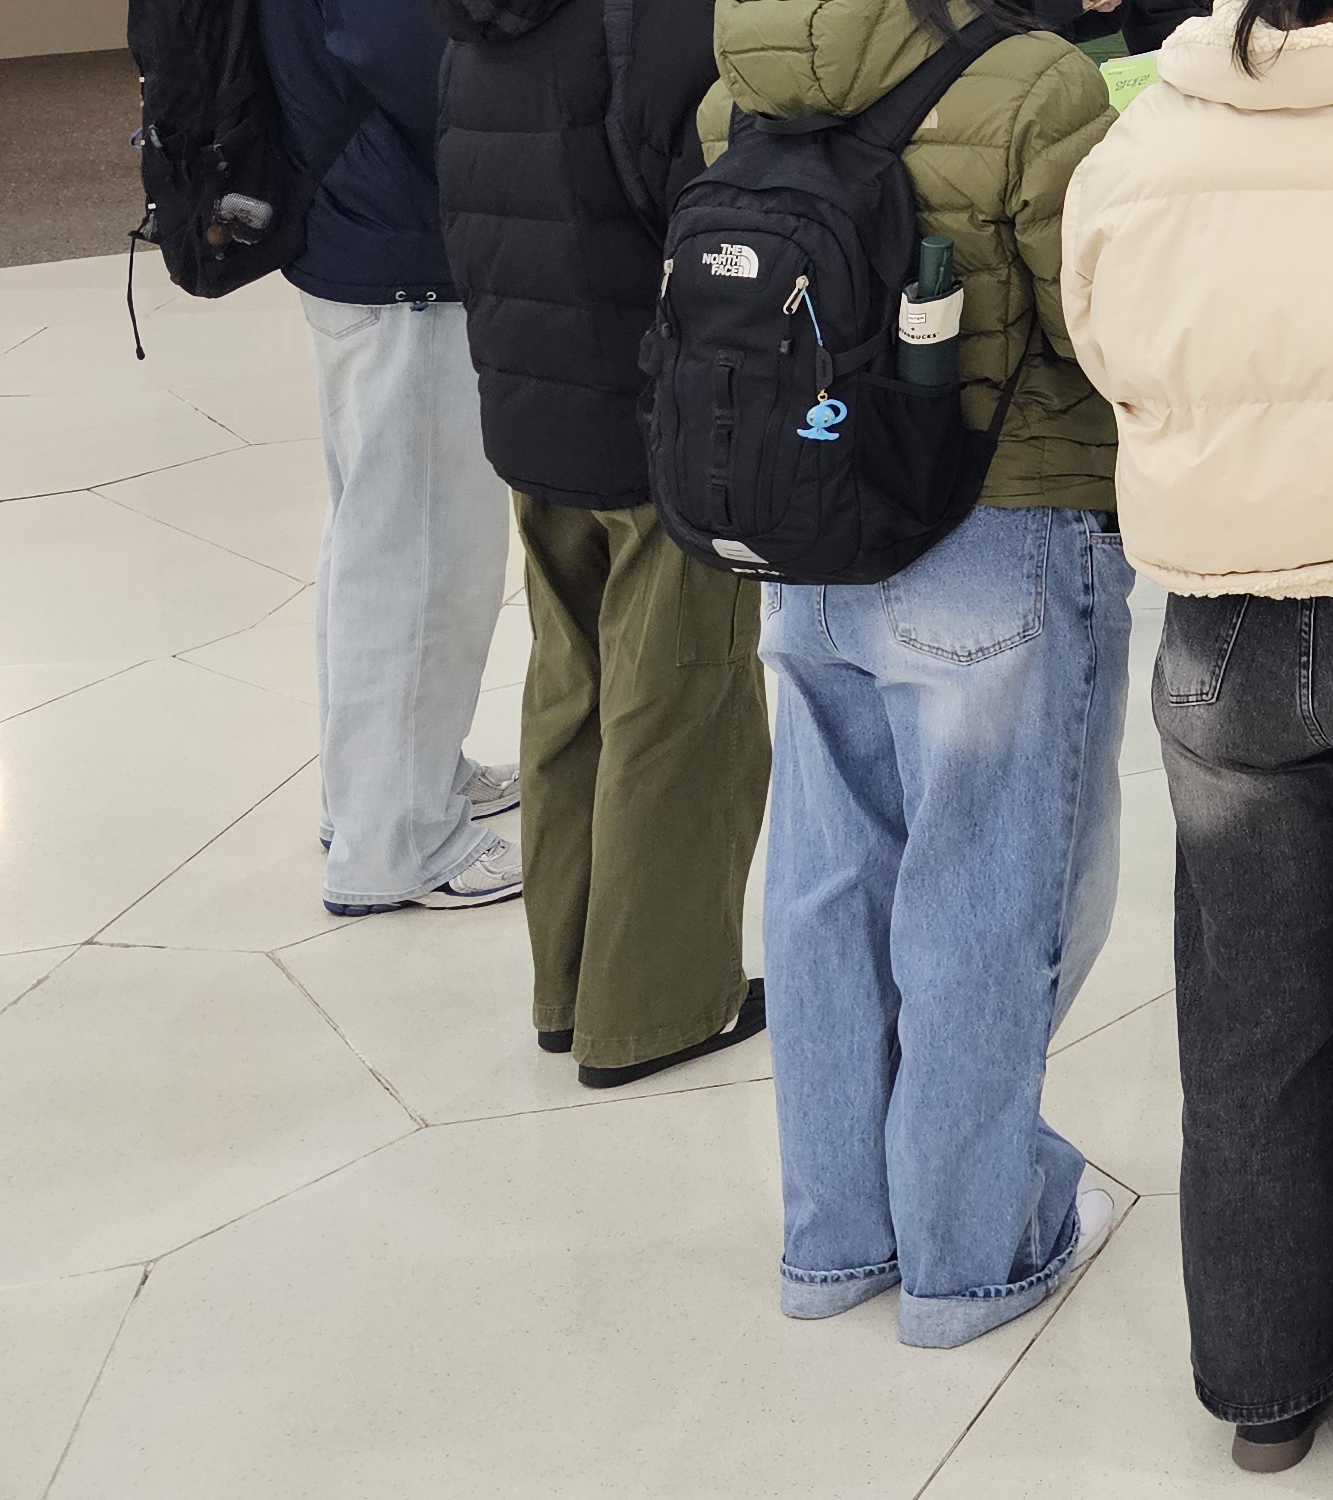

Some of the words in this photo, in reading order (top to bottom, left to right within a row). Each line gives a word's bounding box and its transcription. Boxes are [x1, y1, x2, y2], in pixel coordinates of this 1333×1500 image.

[720, 243, 743, 255] THE
[701, 252, 741, 266] NORTH
[711, 263, 741, 277] FACE
